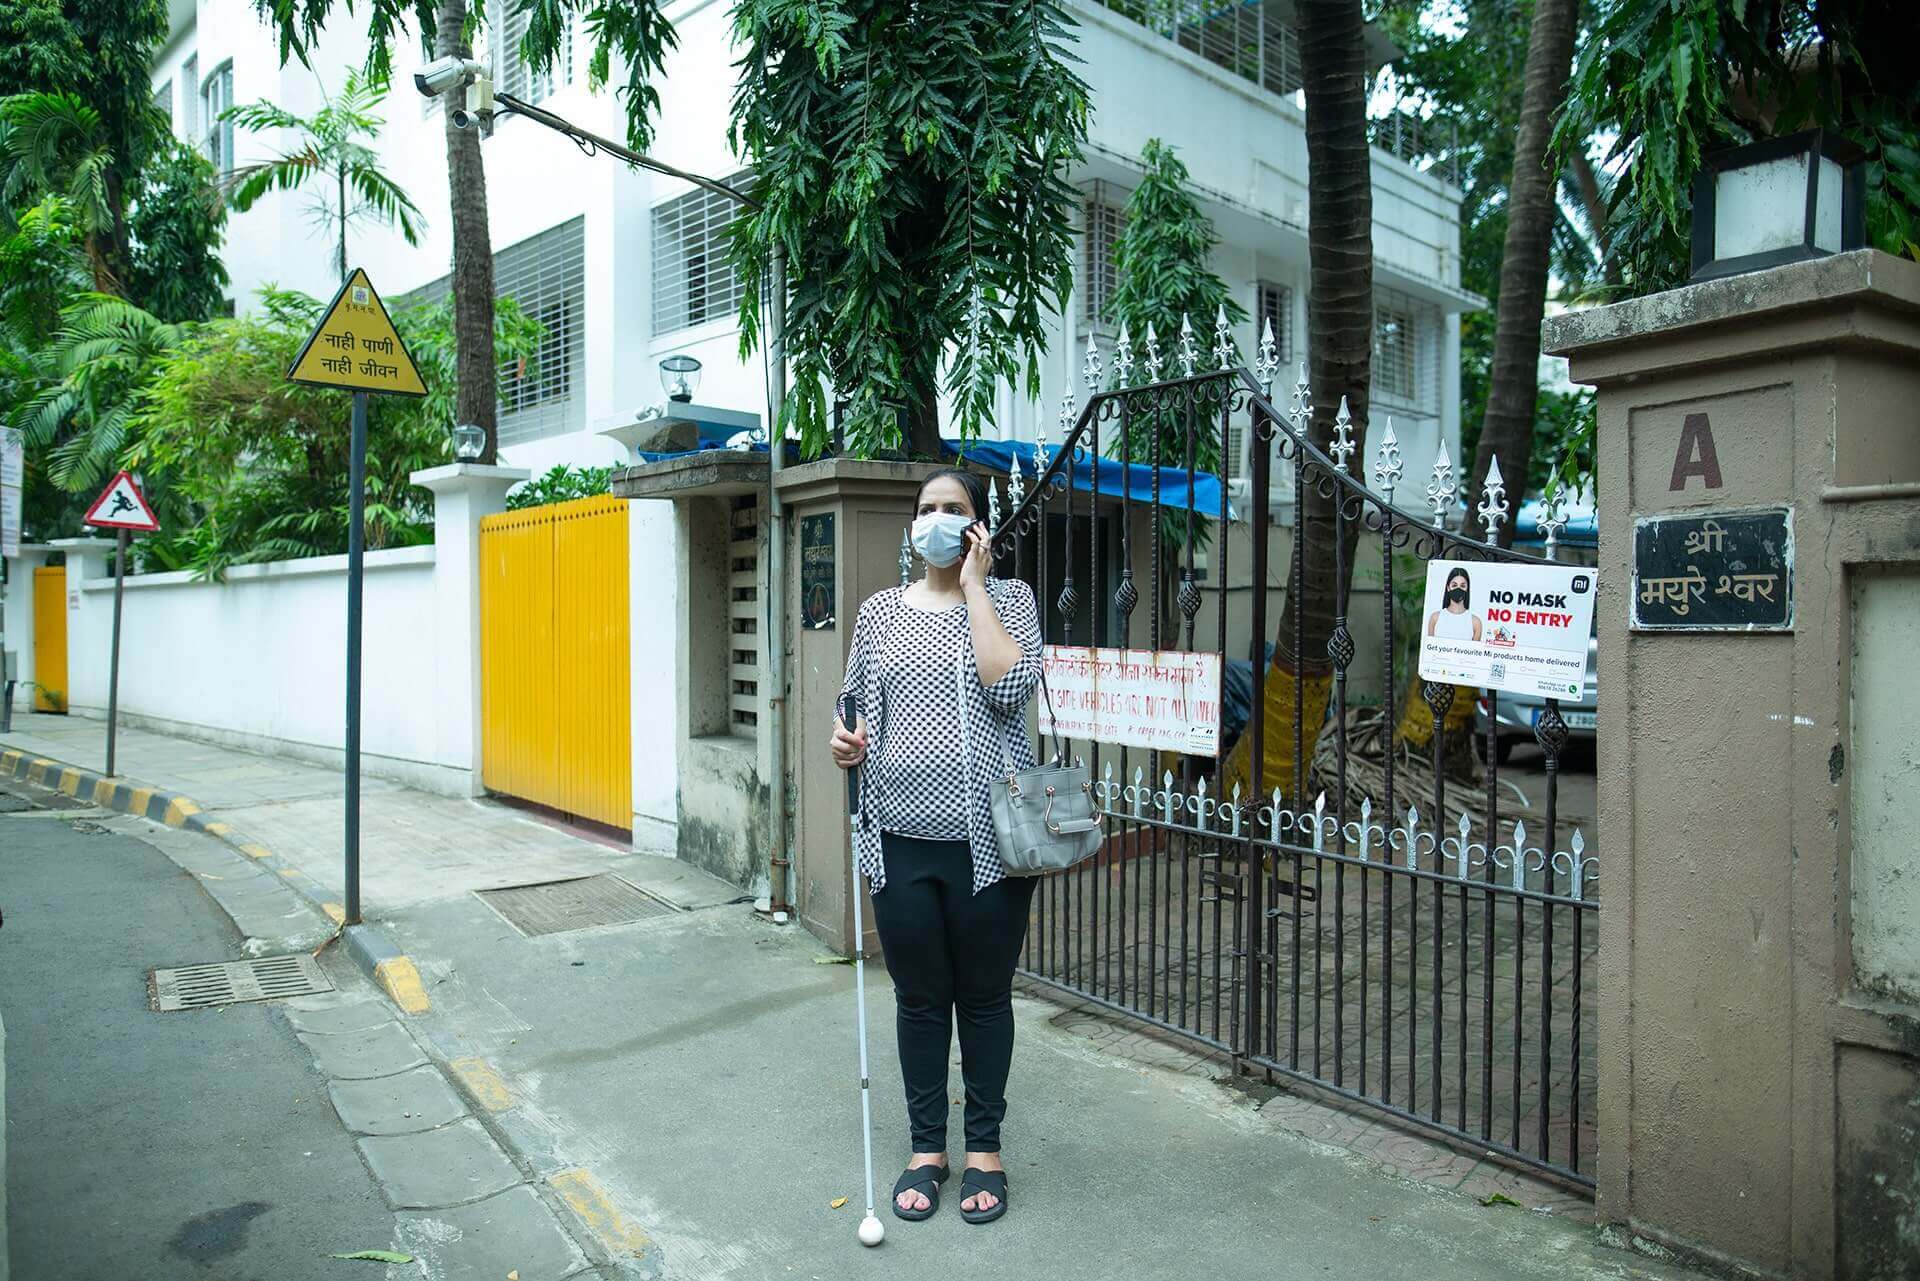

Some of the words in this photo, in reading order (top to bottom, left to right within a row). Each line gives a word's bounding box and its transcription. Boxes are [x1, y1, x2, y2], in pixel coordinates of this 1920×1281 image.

[324, 332, 355, 351] नाही
[361, 337, 394, 355] पाणी
[321, 355, 353, 374] नाही
[358, 359, 398, 380] जीवन
[1669, 413, 1724, 491] A
[1684, 520, 1729, 555] श्री
[1489, 590, 1514, 604] NO
[1517, 592, 1567, 609] MASK
[1487, 608, 1511, 622] NO
[1515, 610, 1573, 628] ENTRY
[1426, 643, 1438, 651] Get
[1438, 645, 1453, 653] your
[1454, 647, 1482, 657] favourite
[1493, 651, 1523, 661] products
[1525, 655, 1545, 664] home
[1546, 658, 1580, 668] delivered
[1144, 695, 1167, 720] NOT
